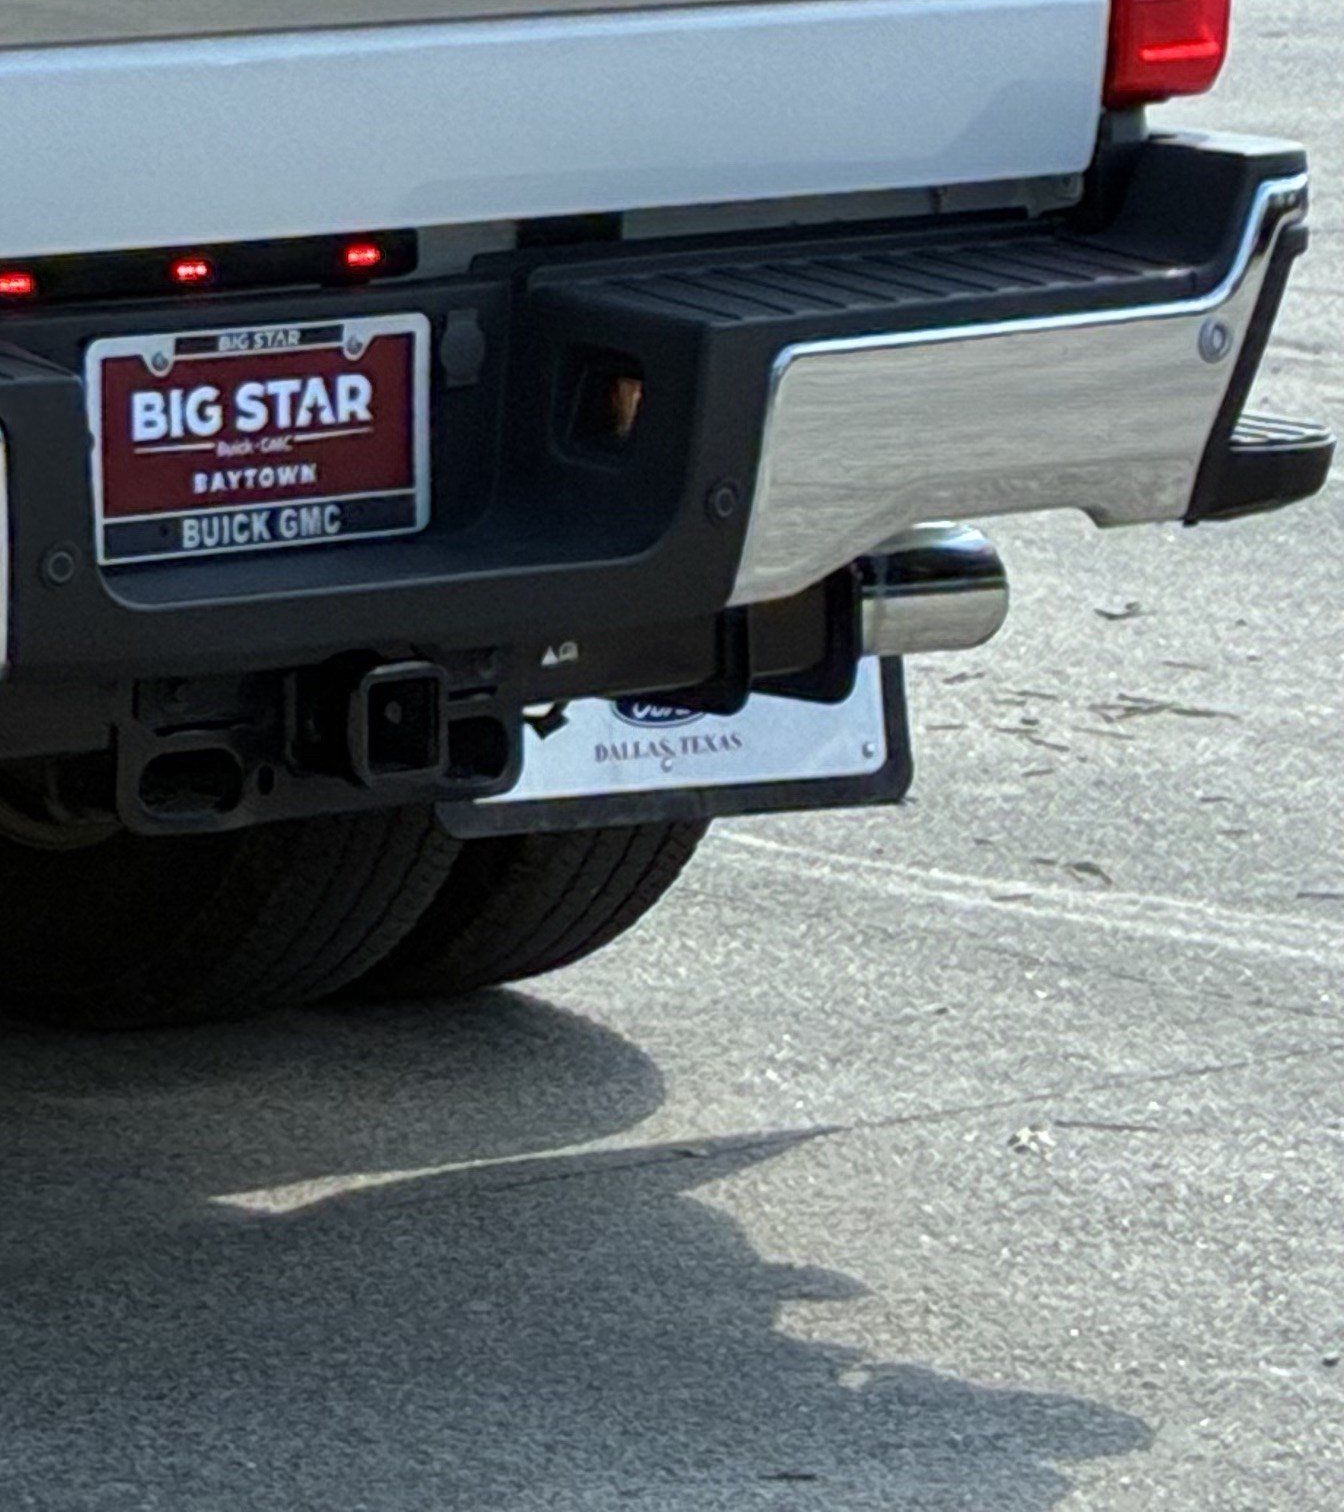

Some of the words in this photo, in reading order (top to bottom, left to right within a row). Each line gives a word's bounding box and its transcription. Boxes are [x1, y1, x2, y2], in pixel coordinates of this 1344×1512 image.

[218, 333, 250, 352] BIG
[253, 329, 301, 350] STAR
[133, 386, 223, 442] BIG
[235, 374, 373, 432] STAR
[193, 463, 317, 494] BAYTOWN
[182, 511, 272, 549] BUICK
[278, 504, 342, 539] GMC
[679, 732, 743, 755] TEXAS
